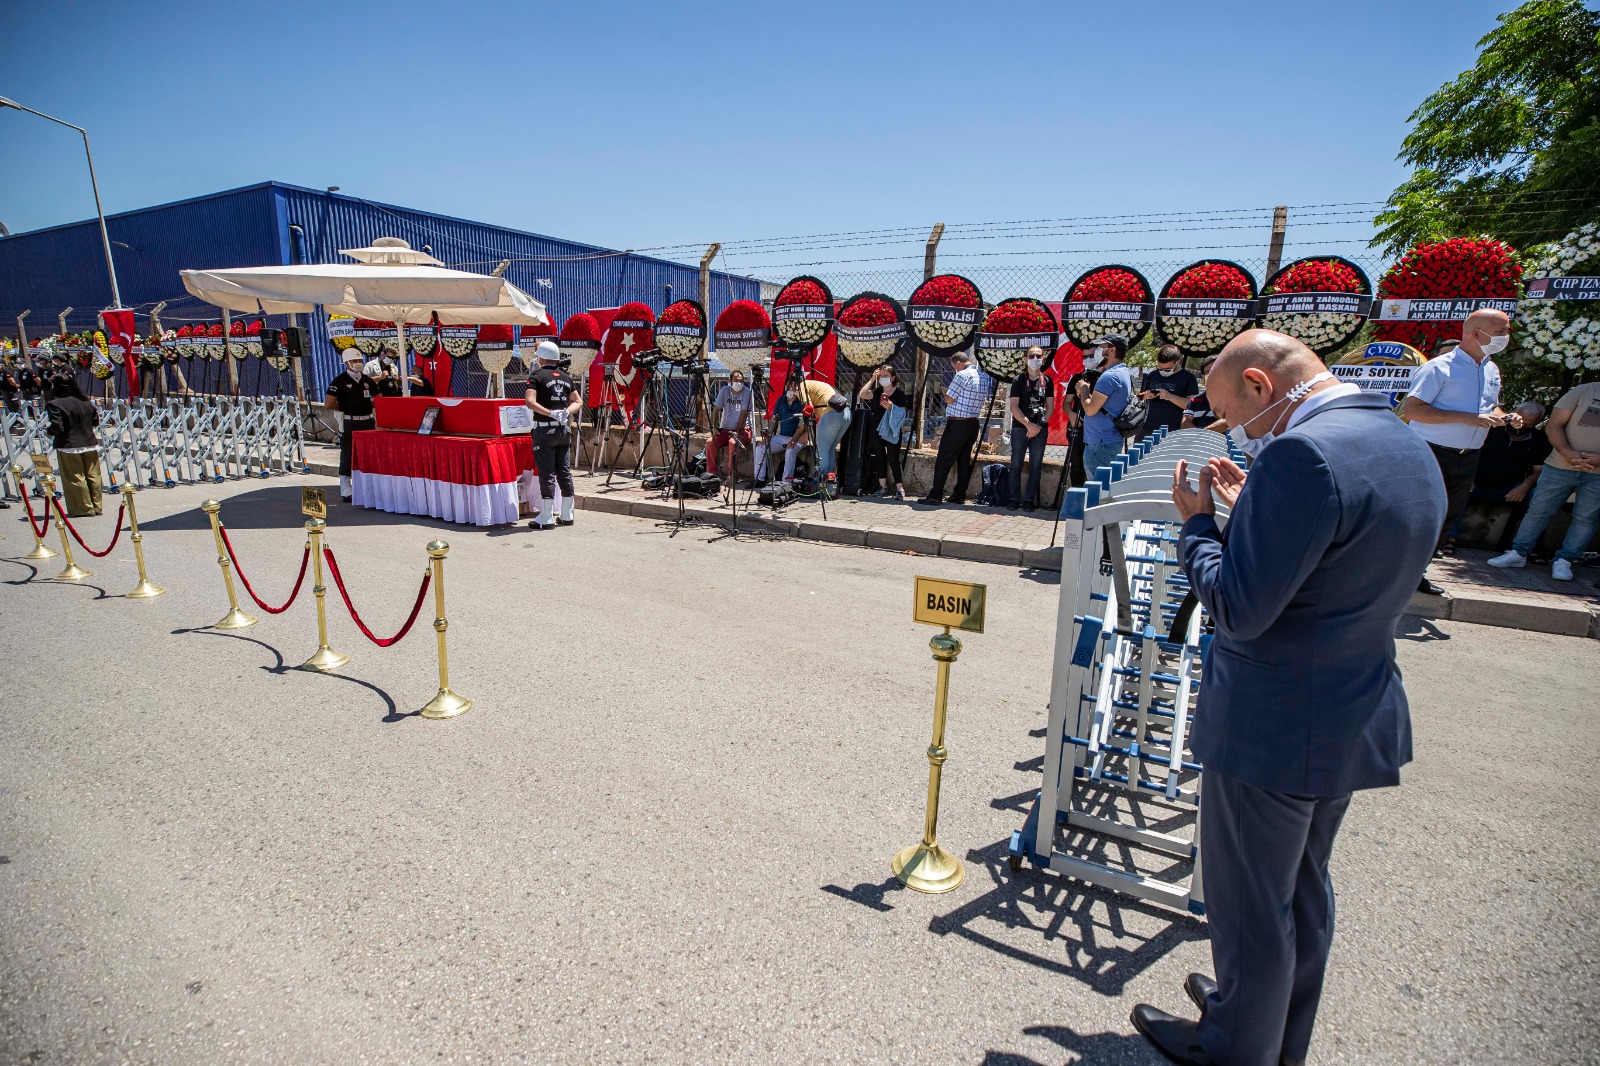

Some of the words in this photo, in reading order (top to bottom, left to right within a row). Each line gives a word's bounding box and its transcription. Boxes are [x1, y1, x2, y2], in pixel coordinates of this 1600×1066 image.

[1553, 278, 1579, 289] CHP
[1316, 295, 1359, 304] ZAİMOĞLU
[1577, 291, 1600, 300] DE
[1093, 303, 1142, 312] GÜVENLİK
[1195, 301, 1216, 309] EMİN
[1219, 302, 1247, 310] BİLMEZ
[1317, 303, 1358, 312] BAŞKANI
[1409, 301, 1451, 311] KEREM
[1455, 299, 1476, 311] ALİ
[912, 308, 935, 319] İZMİR
[941, 310, 975, 322] VALİSİ
[1196, 308, 1238, 316] VALİSİ
[1424, 311, 1449, 319] PARTİ
[1367, 345, 1402, 356] ÇYDD
[1332, 367, 1363, 378] TUNÇ
[1368, 368, 1411, 378] SOYER
[927, 593, 972, 616] BASIN
